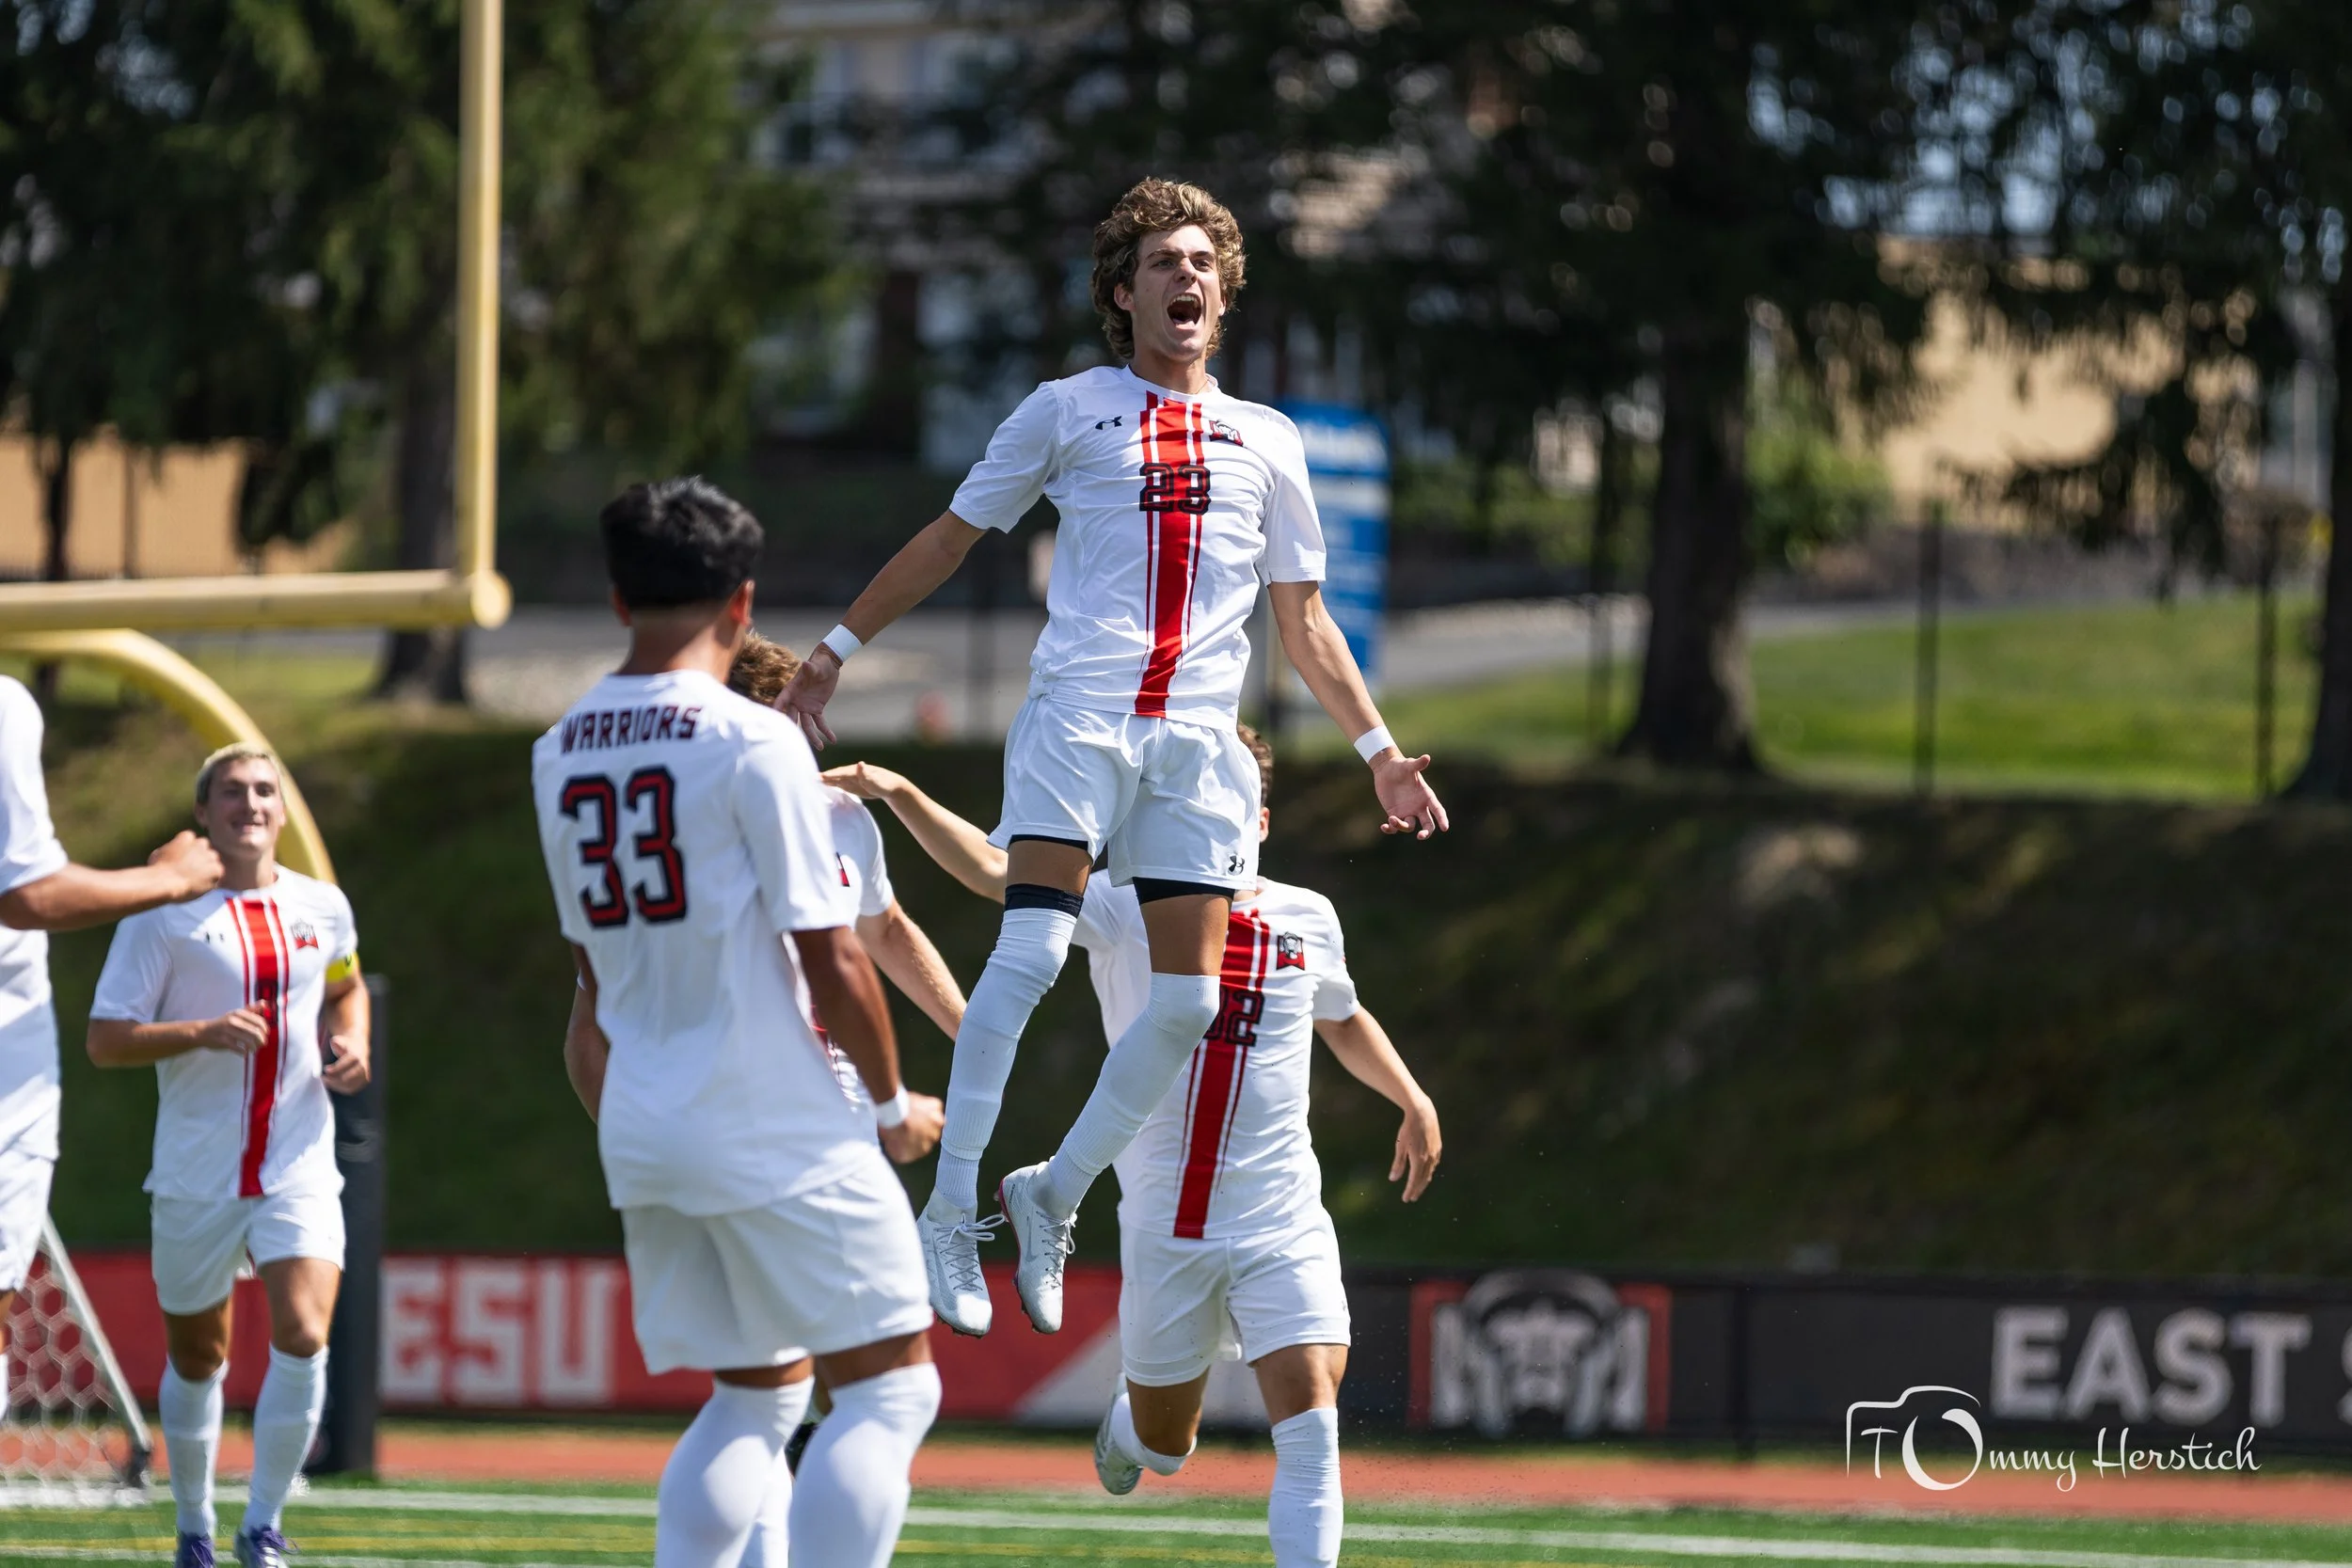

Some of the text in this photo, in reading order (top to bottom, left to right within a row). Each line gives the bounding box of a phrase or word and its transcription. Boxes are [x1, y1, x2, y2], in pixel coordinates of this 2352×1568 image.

[1139, 462, 1211, 515] 23
[560, 705, 702, 753] WARRIORS
[560, 765, 687, 927] 33
[381, 1259, 615, 1404] ESU
[1990, 1306, 2312, 1427] EAST
